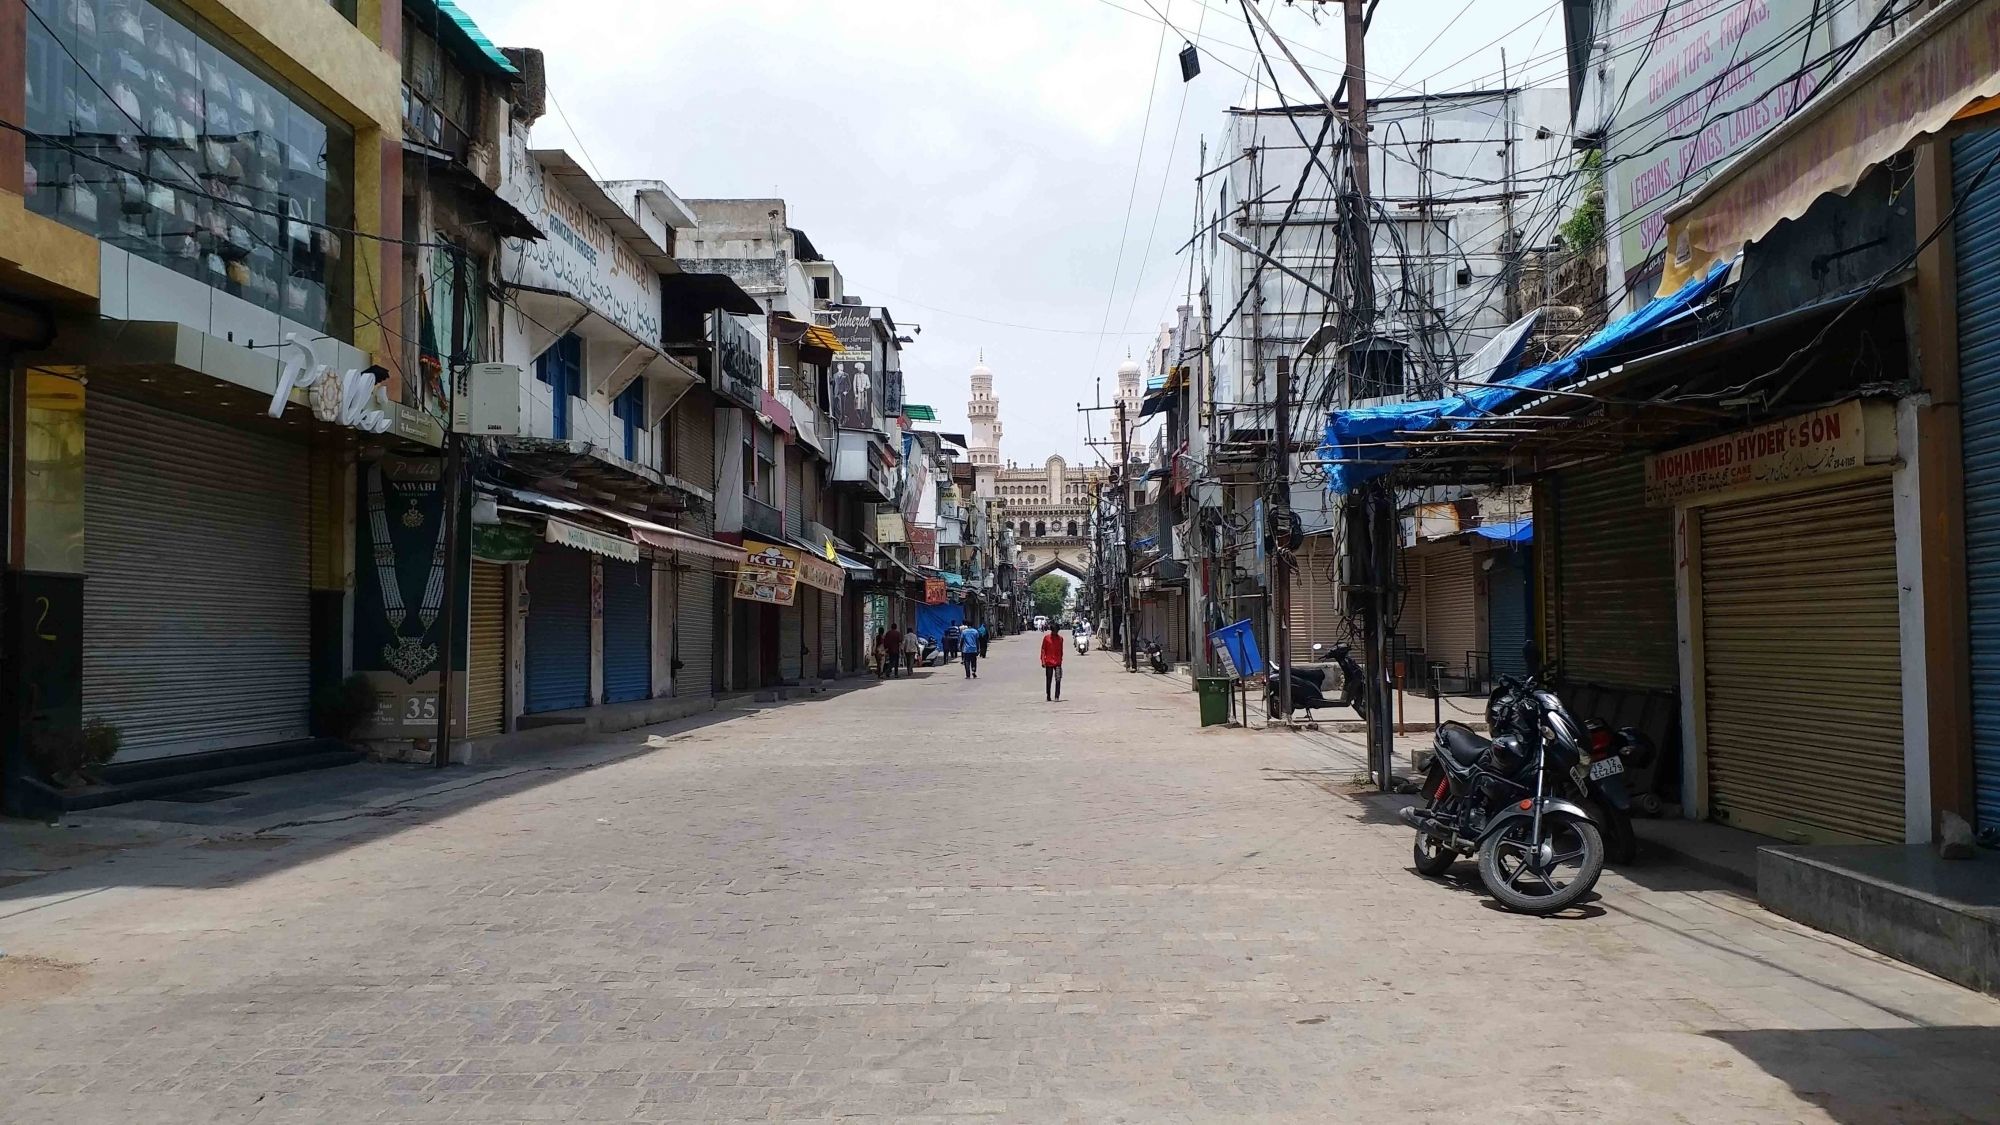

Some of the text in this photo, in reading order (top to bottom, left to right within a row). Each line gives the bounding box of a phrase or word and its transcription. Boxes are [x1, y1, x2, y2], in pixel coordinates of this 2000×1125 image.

[1649, 55, 1680, 105] DENIM
[1683, 30, 1714, 78] TOPS,
[1630, 157, 1674, 209] LEGGINS,
[1727, 96, 1771, 147] LADIES
[549, 213, 573, 249] RAMZAN
[587, 205, 606, 255] Bin
[1655, 441, 1733, 481] MOHAMMED
[1737, 428, 1785, 462] HYDER
[1799, 412, 1841, 448] SON
[392, 482, 437, 492] NAWABI
[35, 596, 57, 641] 2
[406, 697, 436, 719] 35
